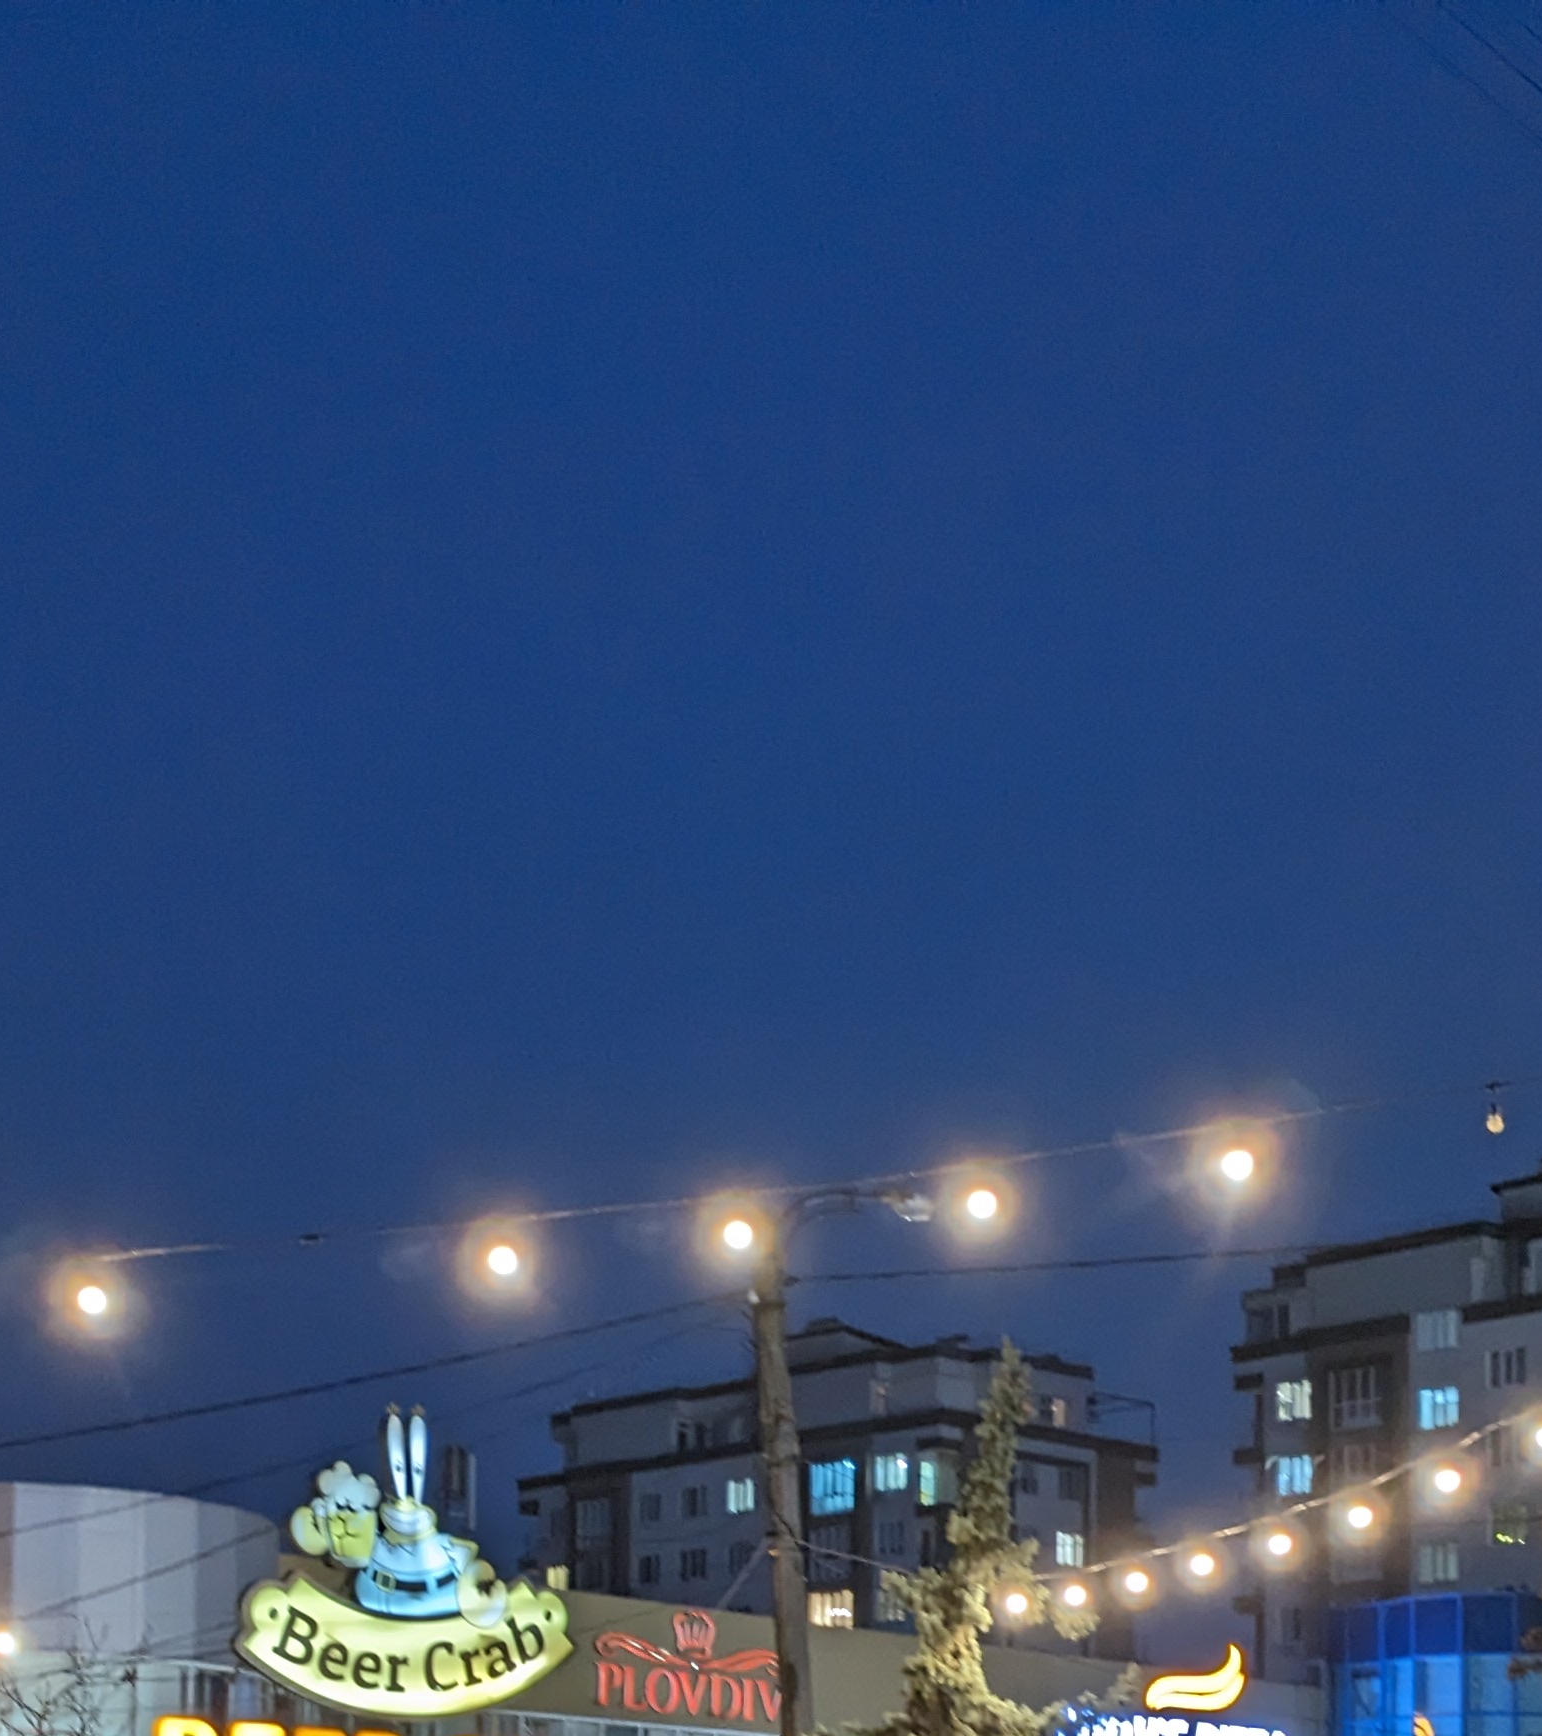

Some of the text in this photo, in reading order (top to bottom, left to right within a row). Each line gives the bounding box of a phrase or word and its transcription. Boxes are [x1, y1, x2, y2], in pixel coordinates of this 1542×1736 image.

[272, 1604, 547, 1693] Beer Crab
[595, 1662, 782, 1723] PLOVDIV
